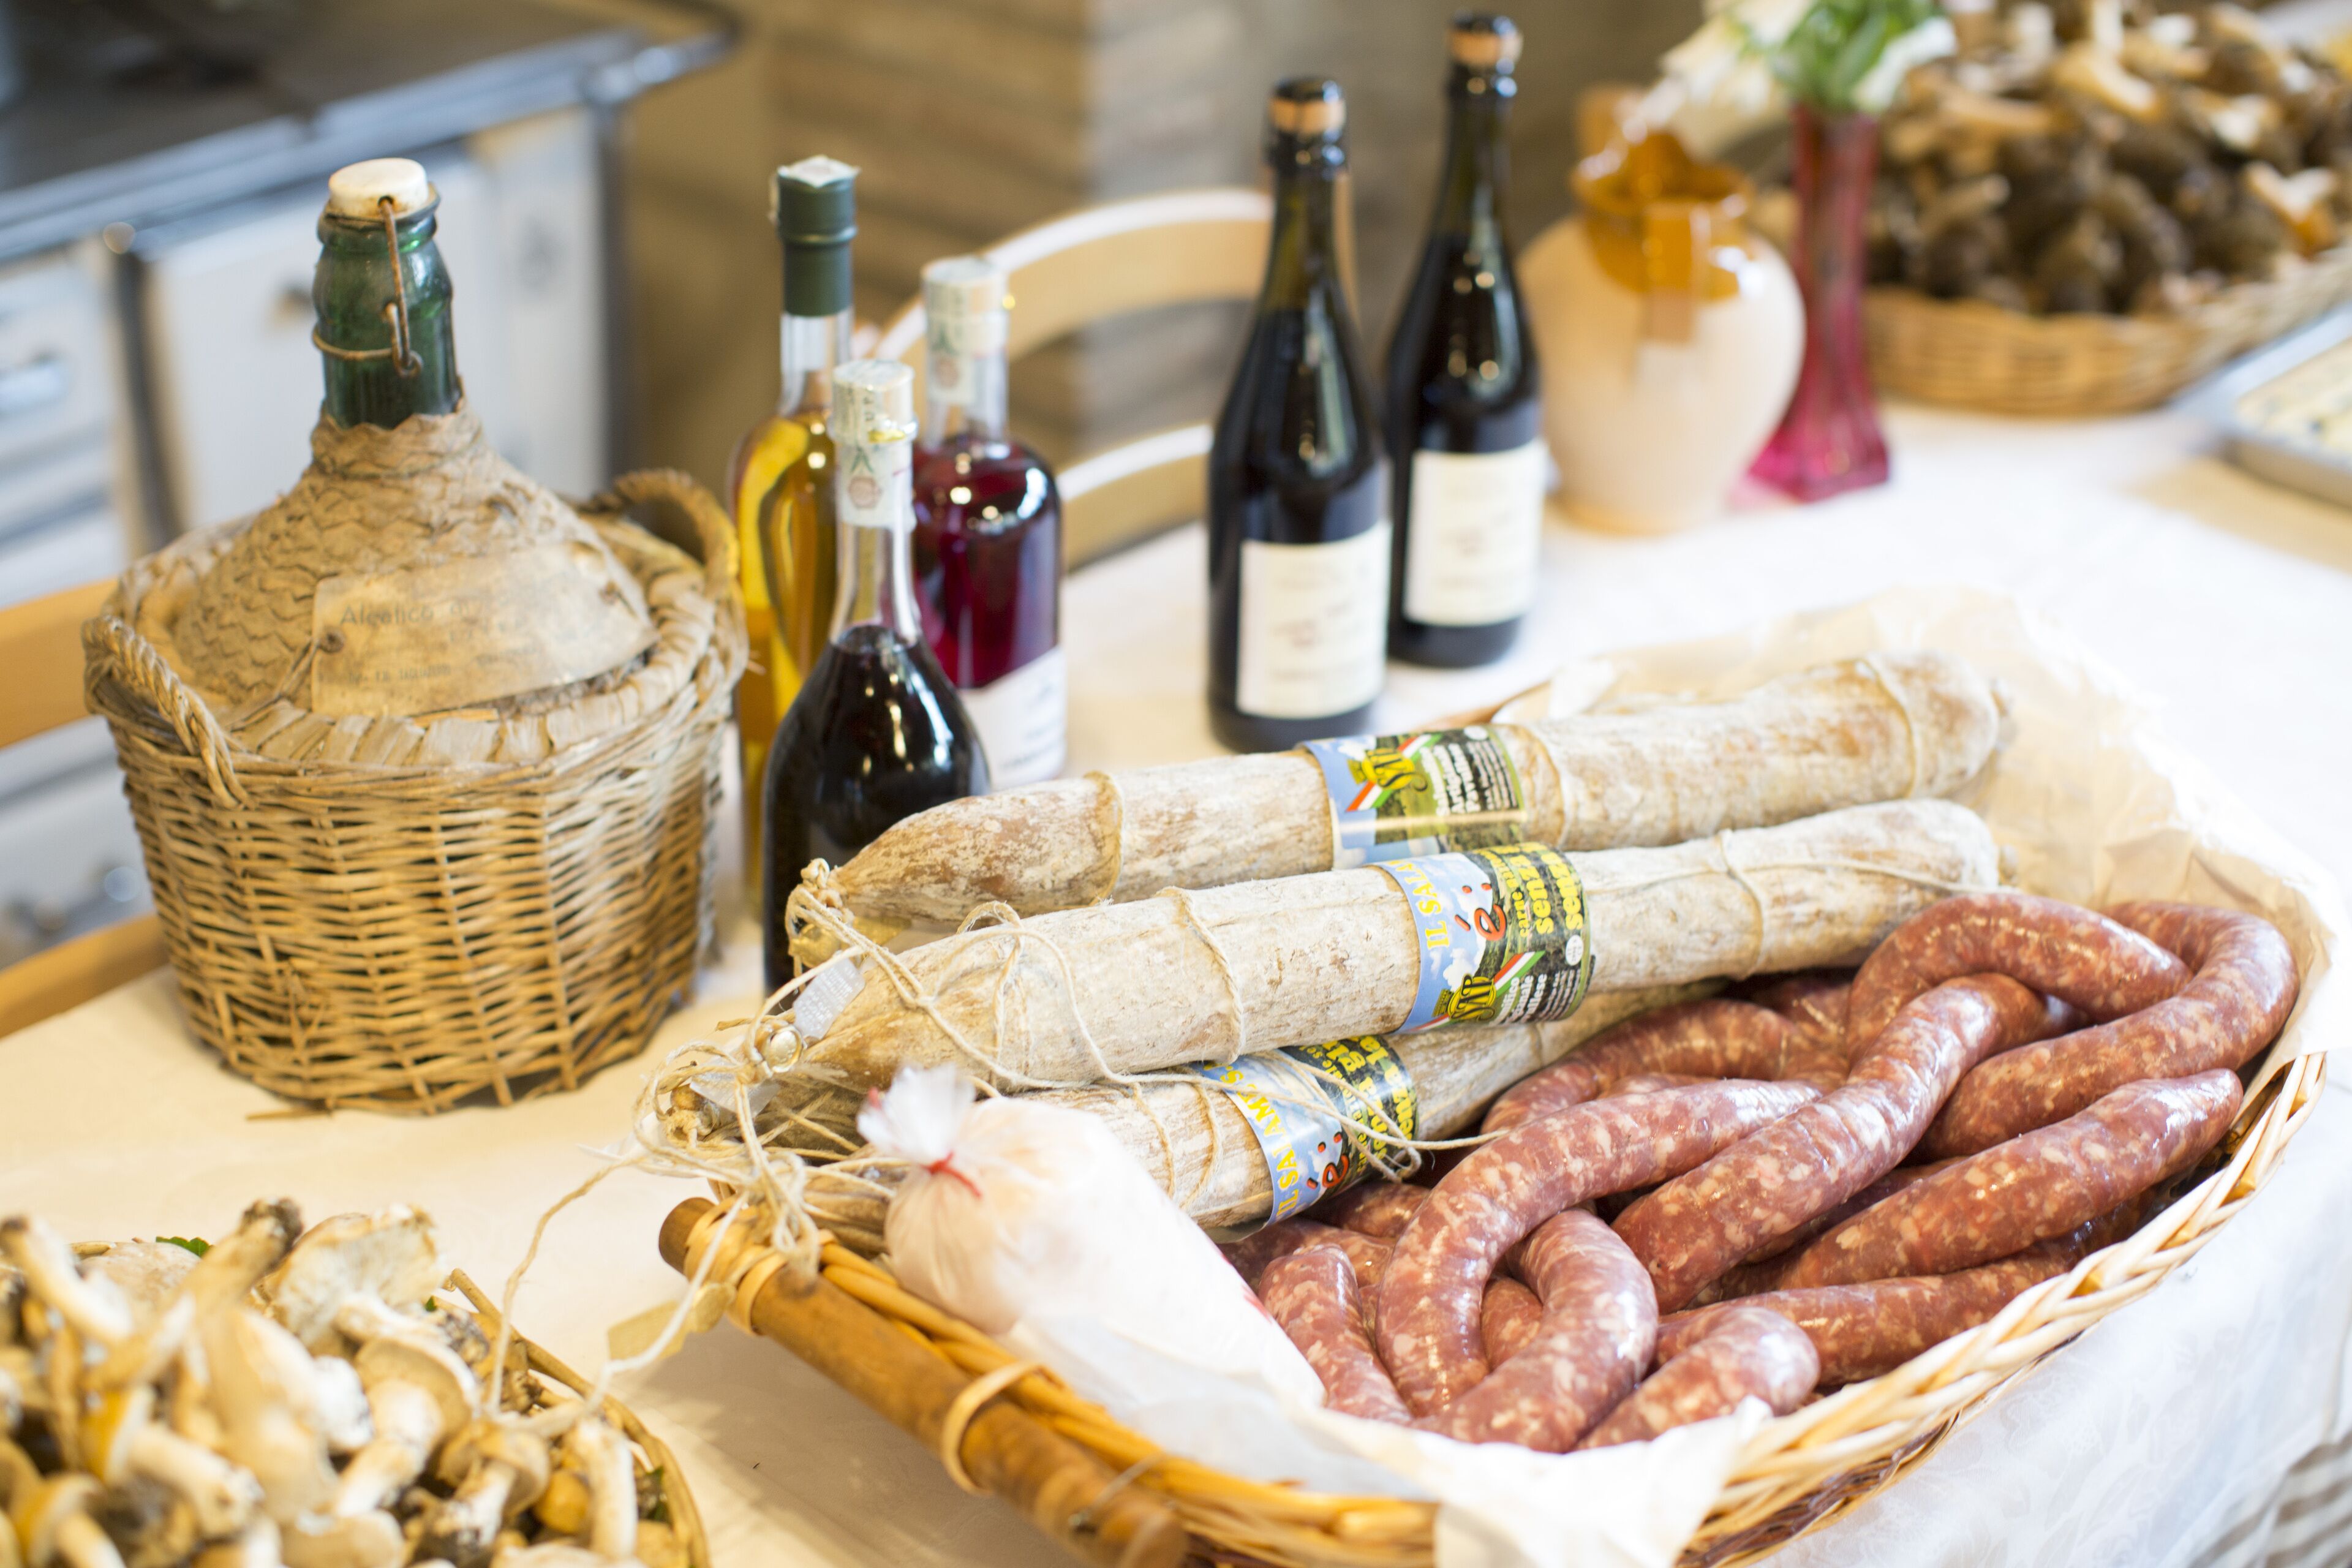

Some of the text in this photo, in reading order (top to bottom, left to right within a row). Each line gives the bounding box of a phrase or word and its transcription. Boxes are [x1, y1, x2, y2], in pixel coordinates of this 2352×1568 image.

[1509, 854, 1555, 935] senza
[1540, 851, 1584, 930] senza
[1425, 920, 1450, 949] IL
[1512, 891, 1529, 938] carne
[1276, 1189, 1299, 1216] IL
